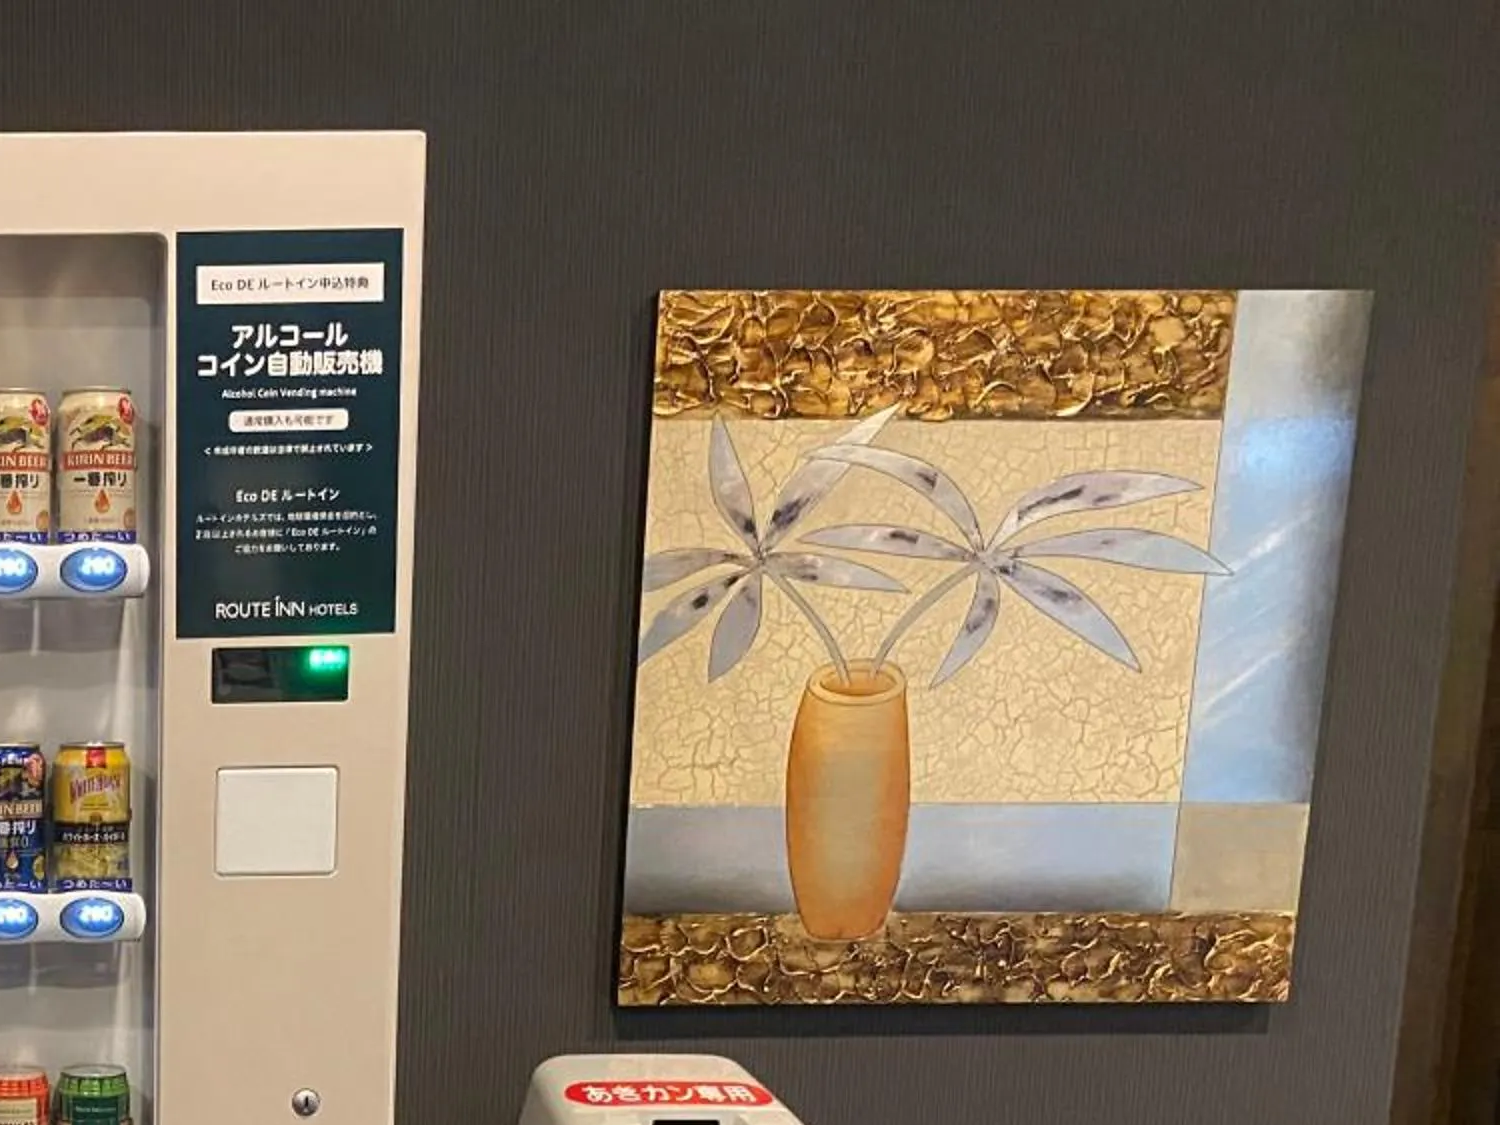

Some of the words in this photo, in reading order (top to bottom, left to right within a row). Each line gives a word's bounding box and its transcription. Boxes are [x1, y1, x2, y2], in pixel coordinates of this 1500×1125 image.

[211, 279, 233, 291] Eco
[237, 277, 254, 290] DE
[231, 322, 348, 349] アルコール
[198, 350, 383, 377] コイン自動販売機
[222, 389, 255, 399] Alcohol
[258, 389, 278, 399] Coin
[280, 388, 317, 399] Vending
[67, 453, 105, 466] KIRIN
[235, 489, 257, 503] Eco
[261, 488, 278, 503] DE
[281, 487, 340, 502] ルートイン
[215, 601, 271, 619] ROUTE
[309, 602, 358, 617] HOTELS
[583, 1085, 758, 1104] あきカン専用
